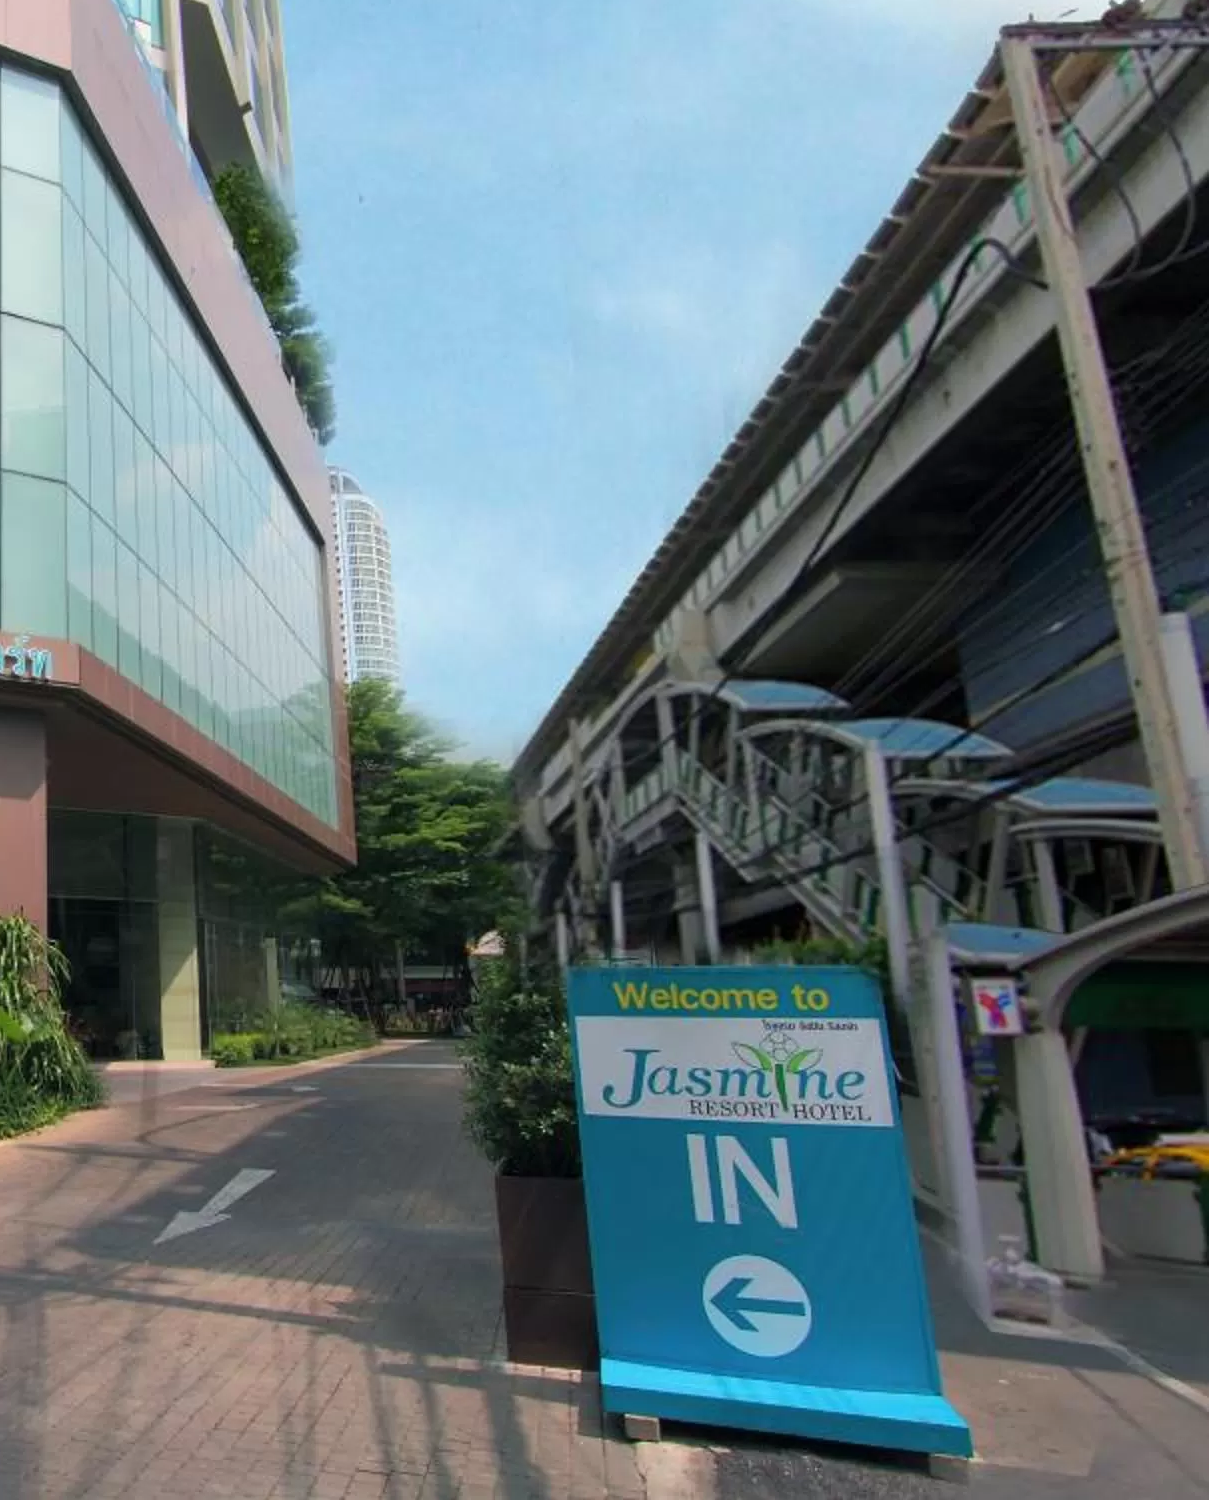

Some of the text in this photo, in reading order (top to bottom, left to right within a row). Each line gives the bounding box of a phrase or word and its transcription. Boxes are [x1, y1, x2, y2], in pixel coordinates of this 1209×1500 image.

[612, 980, 830, 1011] Welcome to
[601, 1047, 866, 1109] Jasmine
[689, 1099, 873, 1123] RESORT HOTEL
[685, 1132, 799, 1230] IN
